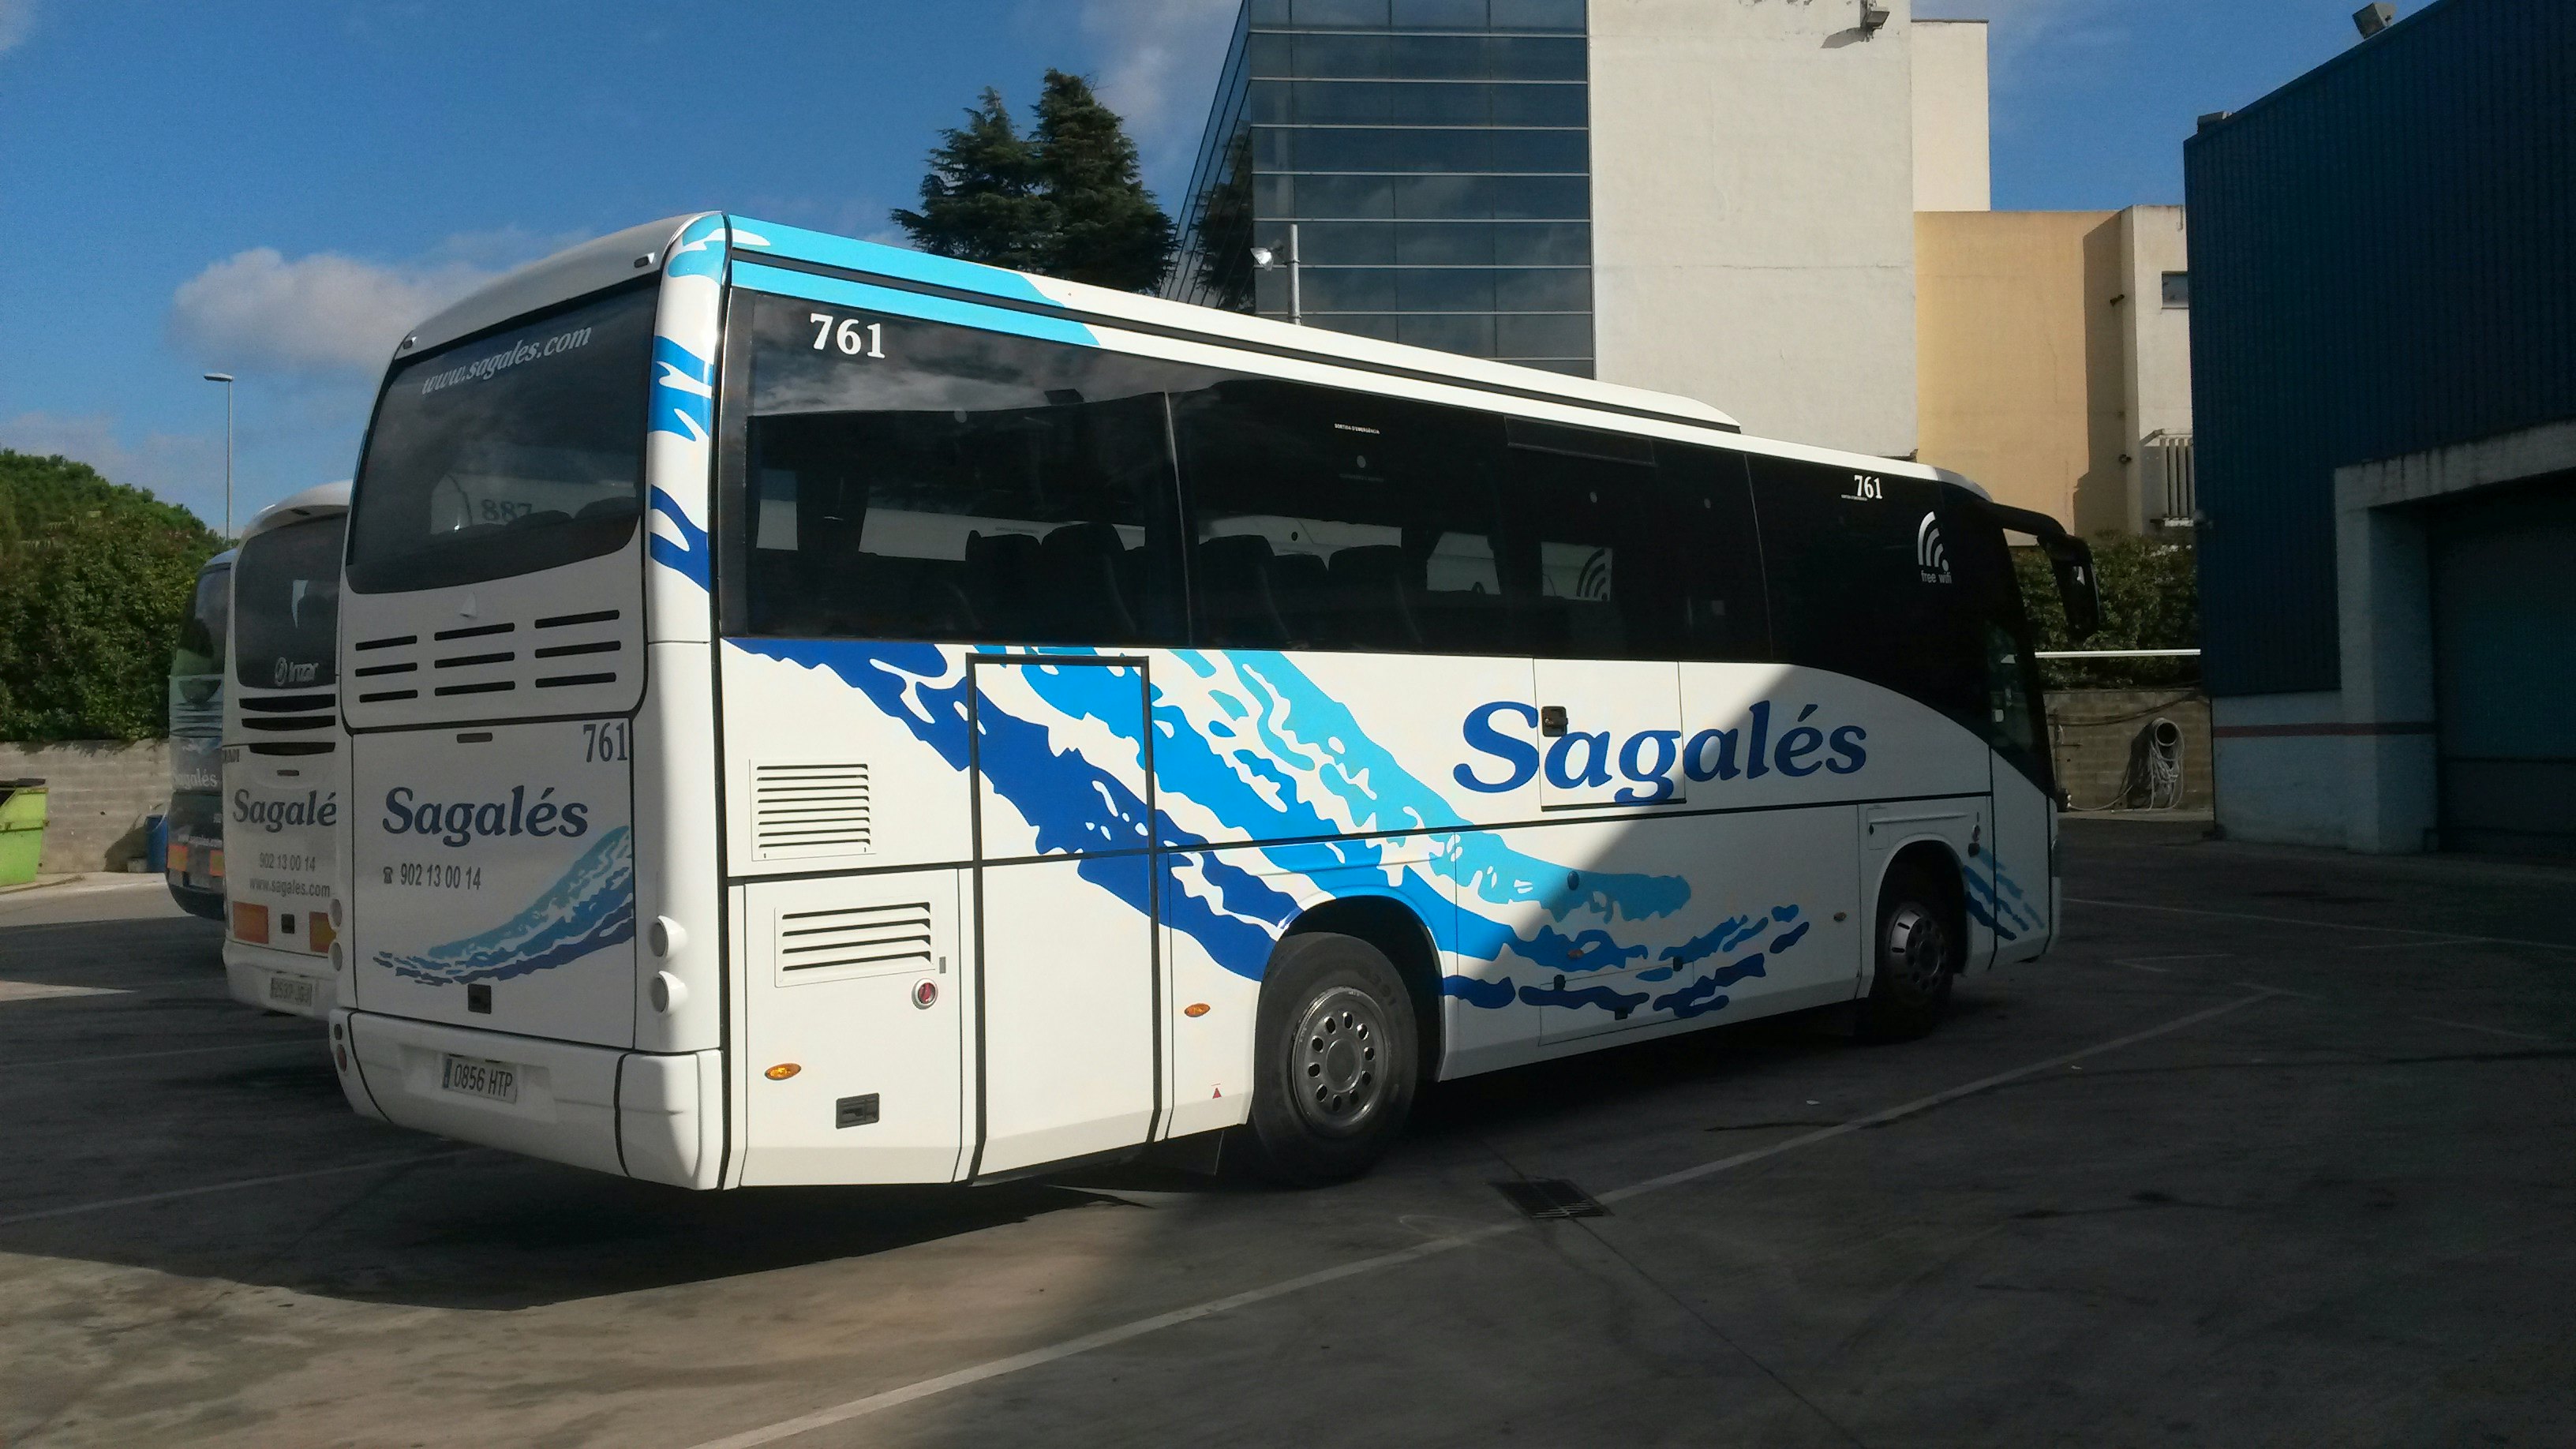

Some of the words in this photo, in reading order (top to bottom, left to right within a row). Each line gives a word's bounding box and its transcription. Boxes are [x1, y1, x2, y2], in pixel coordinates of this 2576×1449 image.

[810, 313, 886, 358] 761
[421, 327, 592, 395] www.sagales.com
[1854, 474, 1883, 499] 761
[480, 499, 533, 522] 887
[1920, 570, 1937, 583] free
[1938, 571, 1953, 584] wifi
[582, 722, 628, 763] 761
[1452, 700, 1867, 804] Sagalés
[233, 788, 338, 833] Sagalé
[382, 784, 589, 848] Sagalés
[259, 852, 274, 869] 902
[277, 854, 288, 871] 13
[290, 855, 301, 871] 00
[305, 856, 316, 872] 14
[400, 863, 422, 886] 902
[427, 863, 441, 888] 13
[445, 865, 461, 889] 00
[466, 867, 481, 890] 14
[249, 878, 331, 898] www.sagales.com
[454, 1064, 486, 1092] 0856
[488, 1069, 513, 1097] HTP
